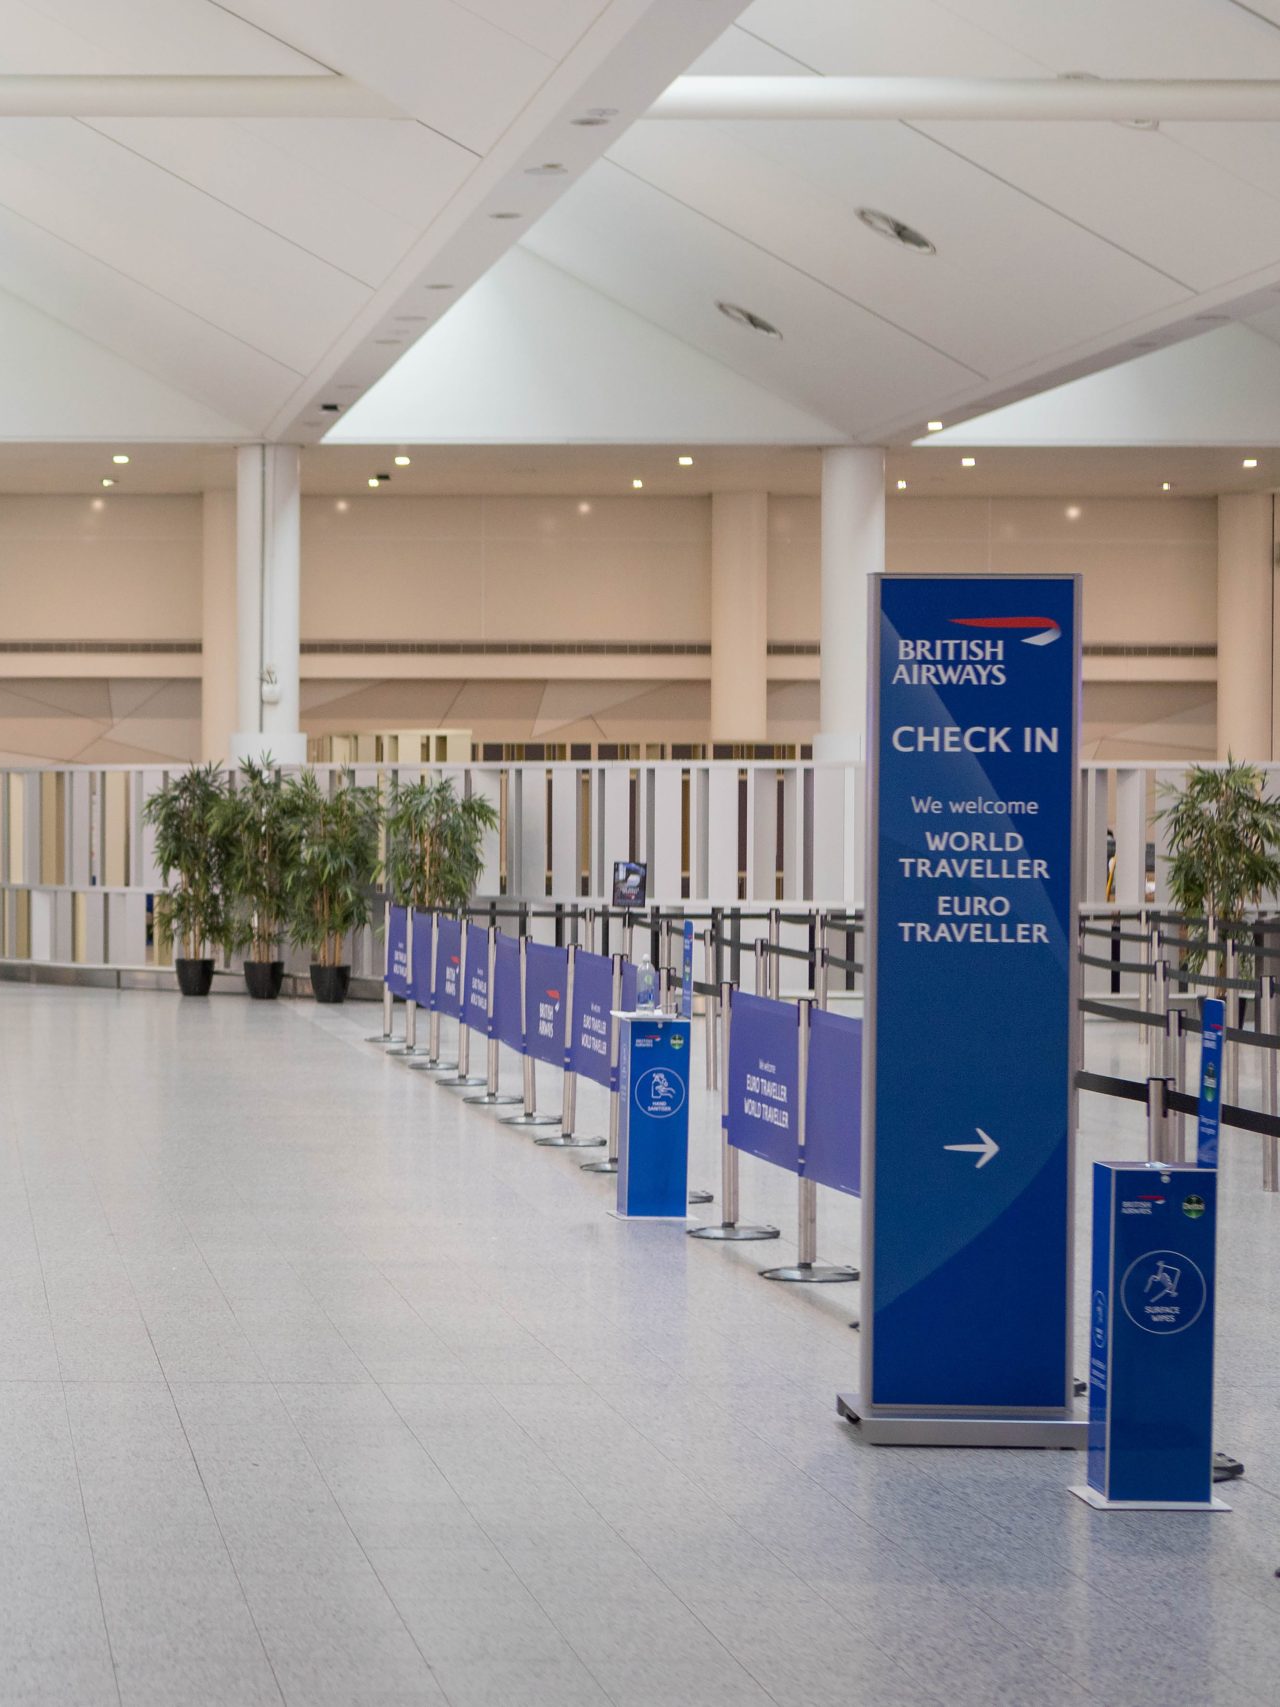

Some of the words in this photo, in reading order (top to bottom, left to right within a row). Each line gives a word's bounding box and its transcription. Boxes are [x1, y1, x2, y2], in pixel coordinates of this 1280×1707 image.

[898, 639, 1004, 661] BRITISH
[891, 663, 1007, 686] AIRWAYS
[892, 725, 1011, 753] CHECK
[1024, 727, 1059, 753] IN
[911, 796, 943, 814] We
[948, 796, 1039, 815] welcome
[925, 831, 1024, 852] WORLD
[898, 858, 1050, 879] TRAVELLER
[938, 895, 1011, 917] EURO
[897, 922, 1049, 944] TRAVELLER
[746, 1073, 760, 1094] EURO
[760, 1077, 788, 1103] TRAVELLER
[743, 1097, 761, 1119] WORLD
[761, 1103, 789, 1129] TRAVELLER
[1144, 1305, 1181, 1314] SURFACE
[1151, 1314, 1176, 1323] WIPES
